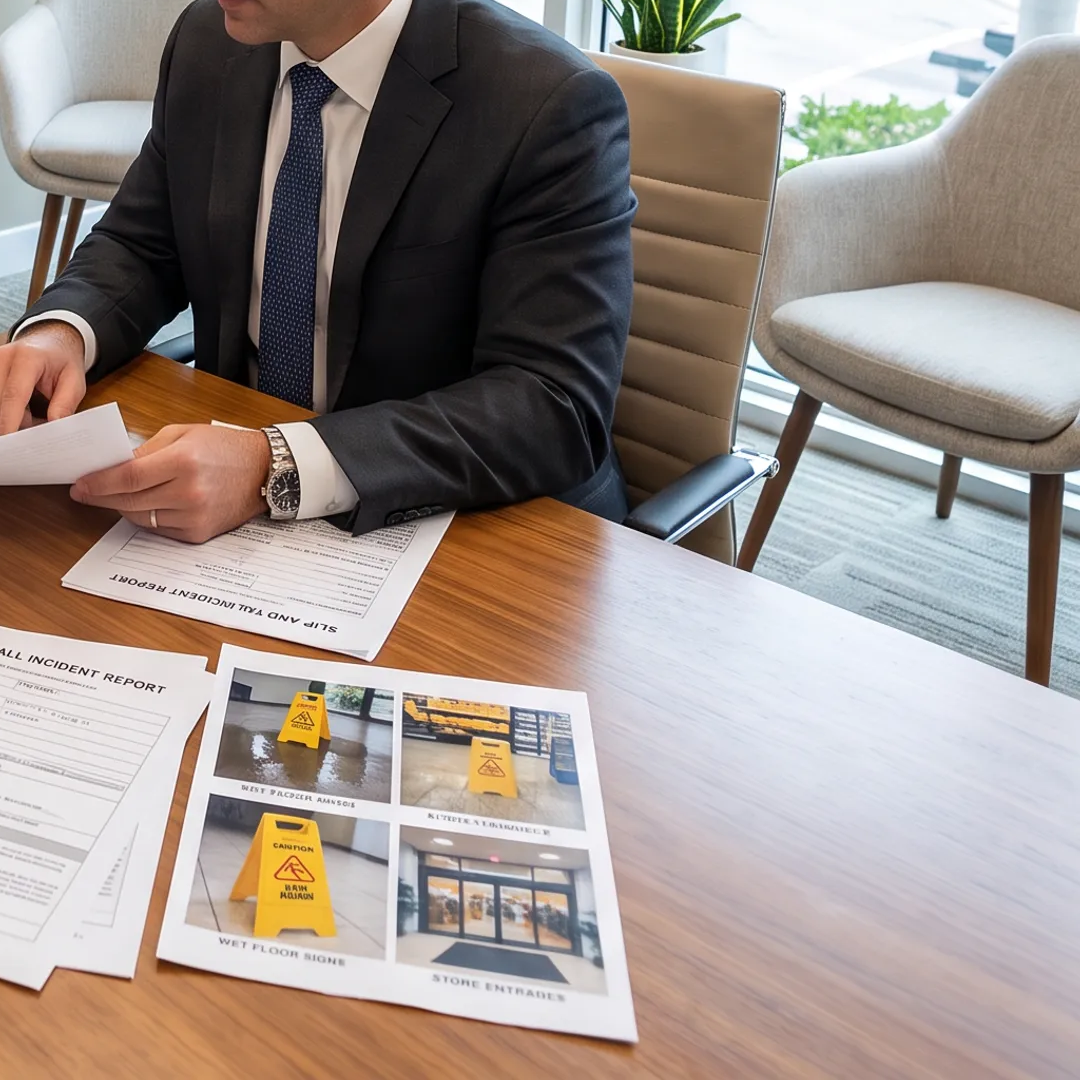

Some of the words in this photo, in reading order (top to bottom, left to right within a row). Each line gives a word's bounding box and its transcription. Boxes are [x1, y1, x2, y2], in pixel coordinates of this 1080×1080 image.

[169, 587, 235, 610] INCIDENT
[267, 611, 301, 624] AND
[303, 622, 338, 634] SLIP
[27, 654, 101, 679] INCIDENT
[103, 672, 167, 695] REPORT
[218, 937, 248, 951] WET
